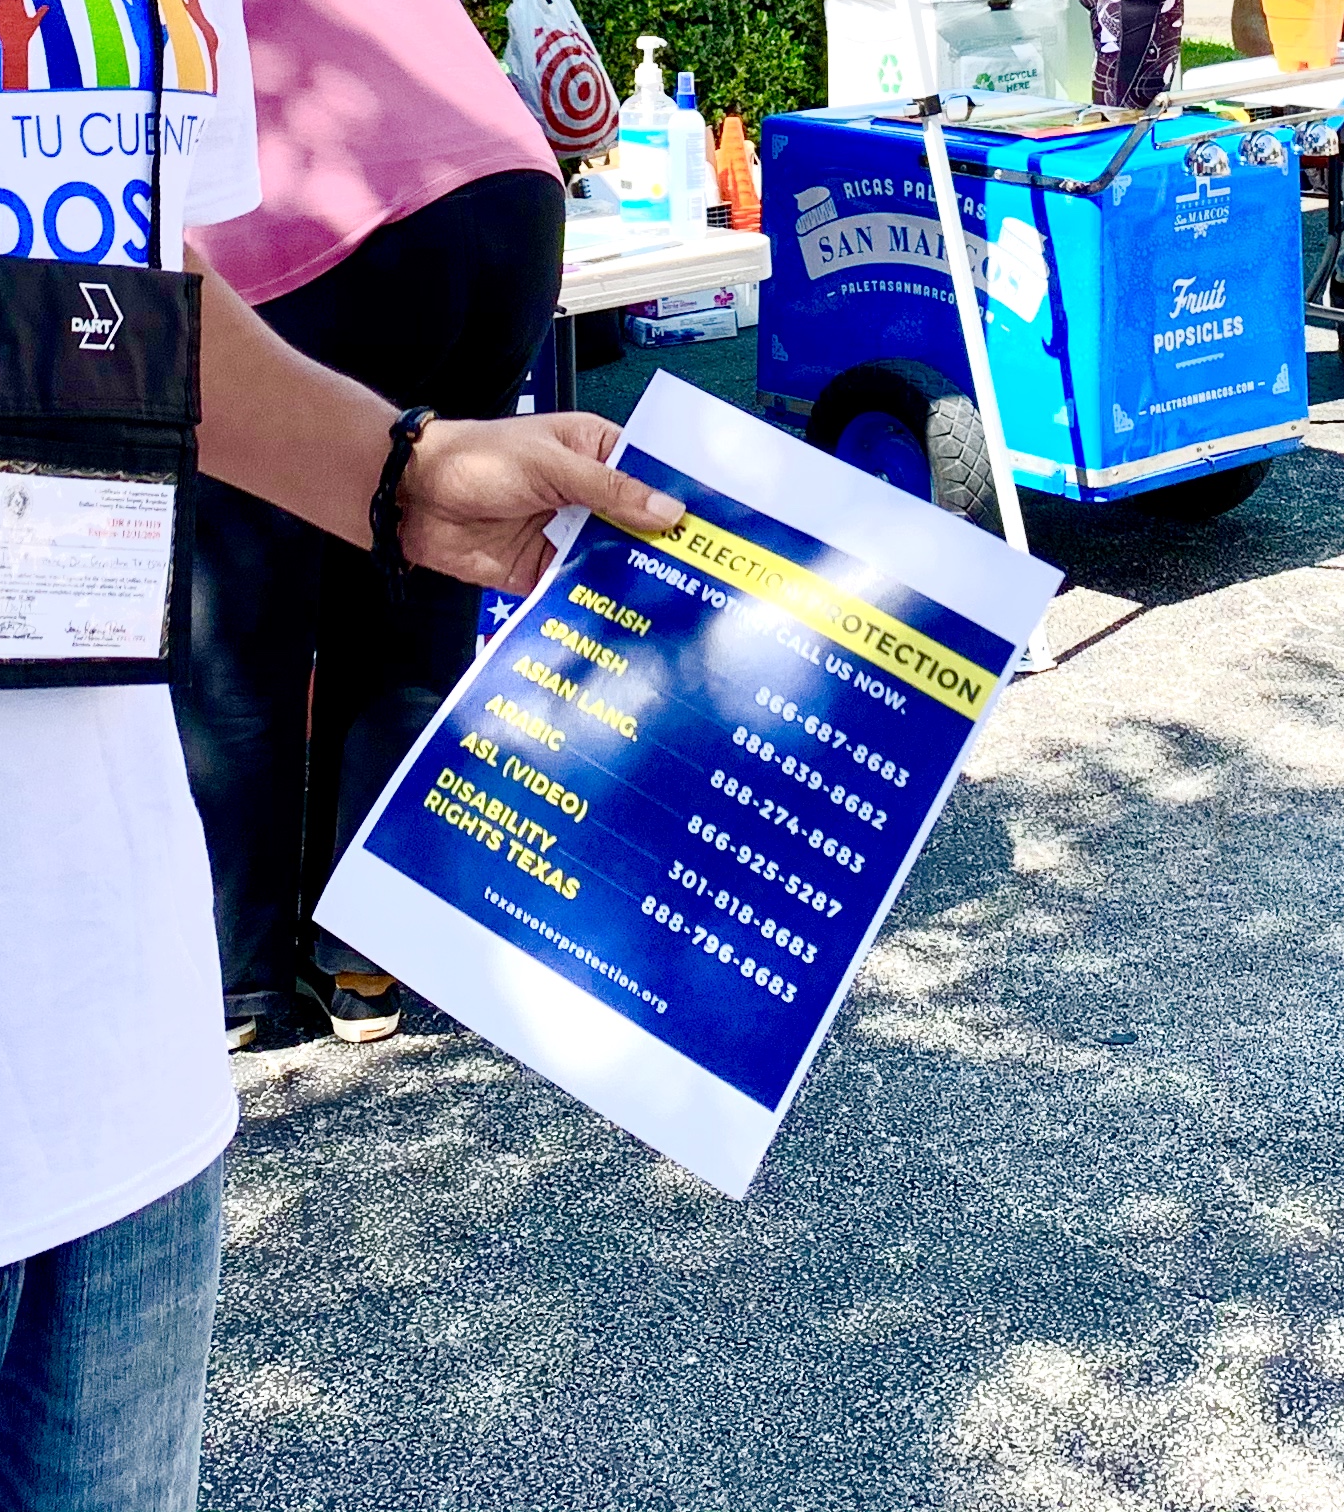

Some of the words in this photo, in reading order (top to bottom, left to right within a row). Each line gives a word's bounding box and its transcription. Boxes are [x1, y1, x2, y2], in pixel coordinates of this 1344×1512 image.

[997, 68, 1038, 84] RECYCLE
[1006, 80, 1031, 93] HERE
[12, 112, 62, 159] TU
[843, 178, 895, 199] RICAS
[903, 180, 987, 220] PALTAS
[1188, 205, 1230, 223] MARCOS
[818, 225, 875, 264] SAN
[71, 316, 113, 334] DART
[1153, 315, 1244, 354] POPSICLES
[1169, 276, 1227, 320] Fruit
[1149, 380, 1255, 416] PALETASANMARCOS.COM
[626, 548, 701, 596] TROUBLE
[775, 627, 821, 666] CALL
[825, 653, 853, 681] US
[853, 670, 907, 715] NOW.
[810, 594, 983, 706] ROTECTION
[540, 617, 629, 677] SPANISH
[732, 725, 888, 831] 888-839-8682
[567, 583, 652, 637] ENGLISH
[755, 685, 910, 788] 866-687-8683
[484, 694, 567, 752] ARABIC
[687, 814, 843, 919] 866-925-5287
[512, 655, 579, 702] ASIAN
[576, 689, 639, 743] LANG.
[710, 769, 866, 874] 888-274-8683
[423, 788, 505, 852] RIGHTS
[506, 838, 581, 901] TEXAS
[436, 767, 558, 854] DISABILITY
[459, 731, 500, 768] ASL
[502, 755, 589, 824] (VIDEO)
[668, 859, 819, 964] 301-818-8683
[484, 885, 668, 1015] texasvoterprotection.org
[640, 894, 798, 1004] 888-796-8683
